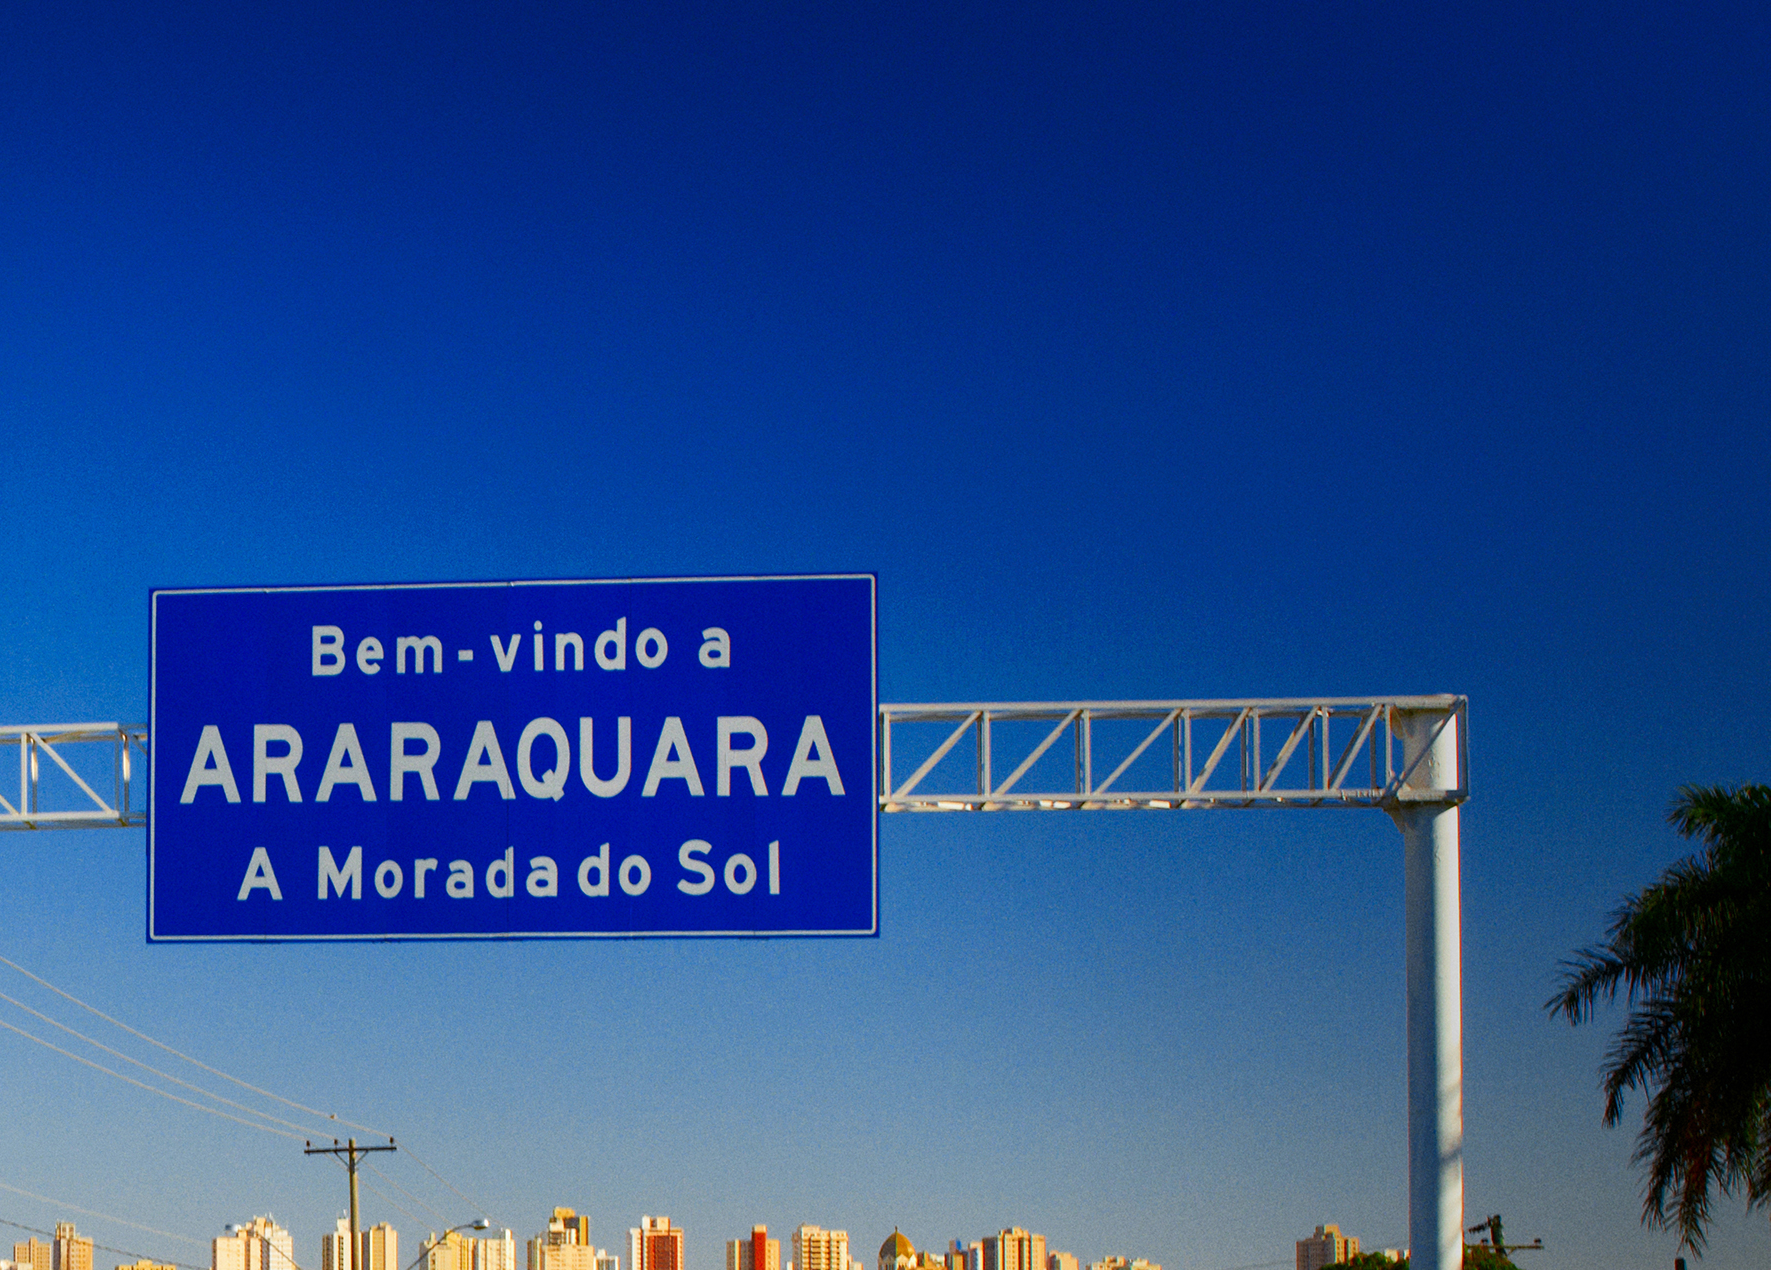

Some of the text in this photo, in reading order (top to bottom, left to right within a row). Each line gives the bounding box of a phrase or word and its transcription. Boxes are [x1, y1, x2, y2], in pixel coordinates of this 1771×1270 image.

[698, 626, 731, 669] a
[180, 714, 846, 804] ARARAQUARA
[237, 838, 781, 901] A Morada do Sol
